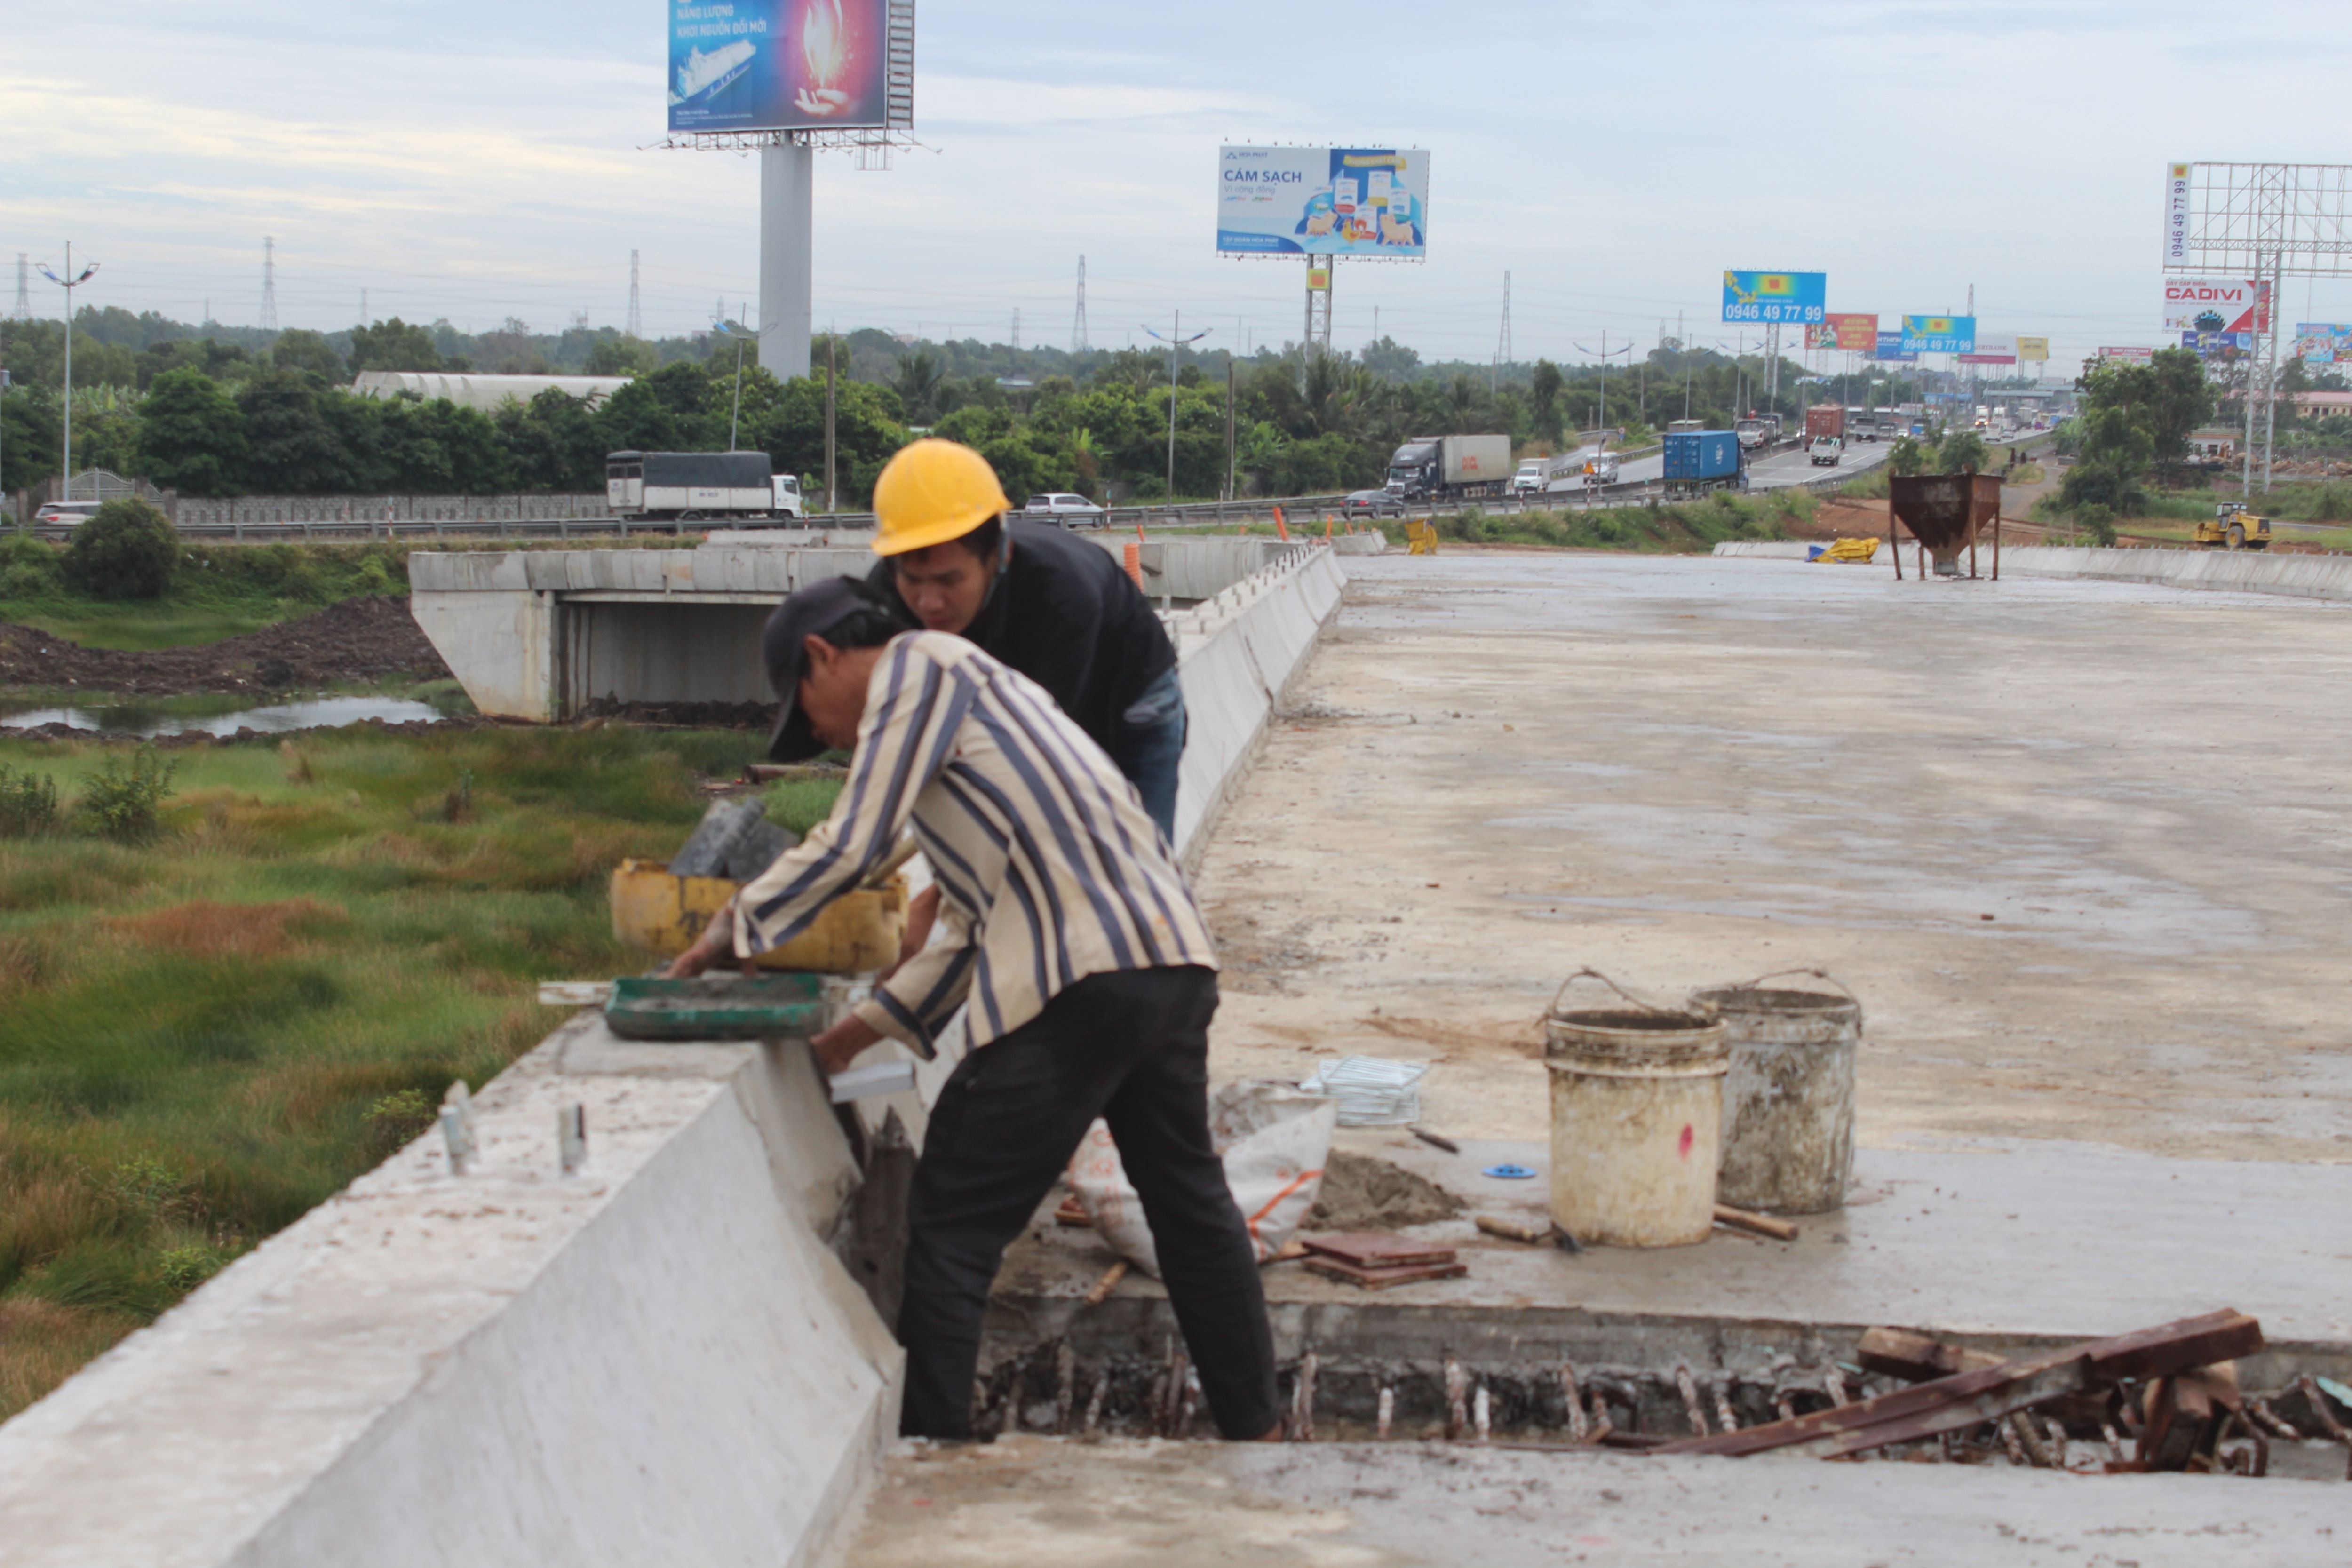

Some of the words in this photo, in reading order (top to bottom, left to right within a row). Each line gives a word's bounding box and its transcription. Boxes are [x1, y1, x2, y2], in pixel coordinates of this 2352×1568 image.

[1224, 167, 1258, 182] CÁM
[1263, 170, 1302, 185] SẠCH
[2174, 181, 2185, 193] 99
[2173, 198, 2185, 210] 77
[2173, 215, 2184, 227] 49
[2171, 231, 2183, 257] 0946
[2166, 288, 2242, 301] CADIVI
[1725, 304, 1759, 319] 0946
[1763, 305, 1780, 319] 49
[1784, 305, 1801, 320] 77
[1805, 306, 1822, 321] 99
[1904, 339, 1927, 350] 0946
[1930, 340, 1942, 350] 49
[1945, 340, 1956, 350] 77
[1959, 341, 1971, 350] 99
